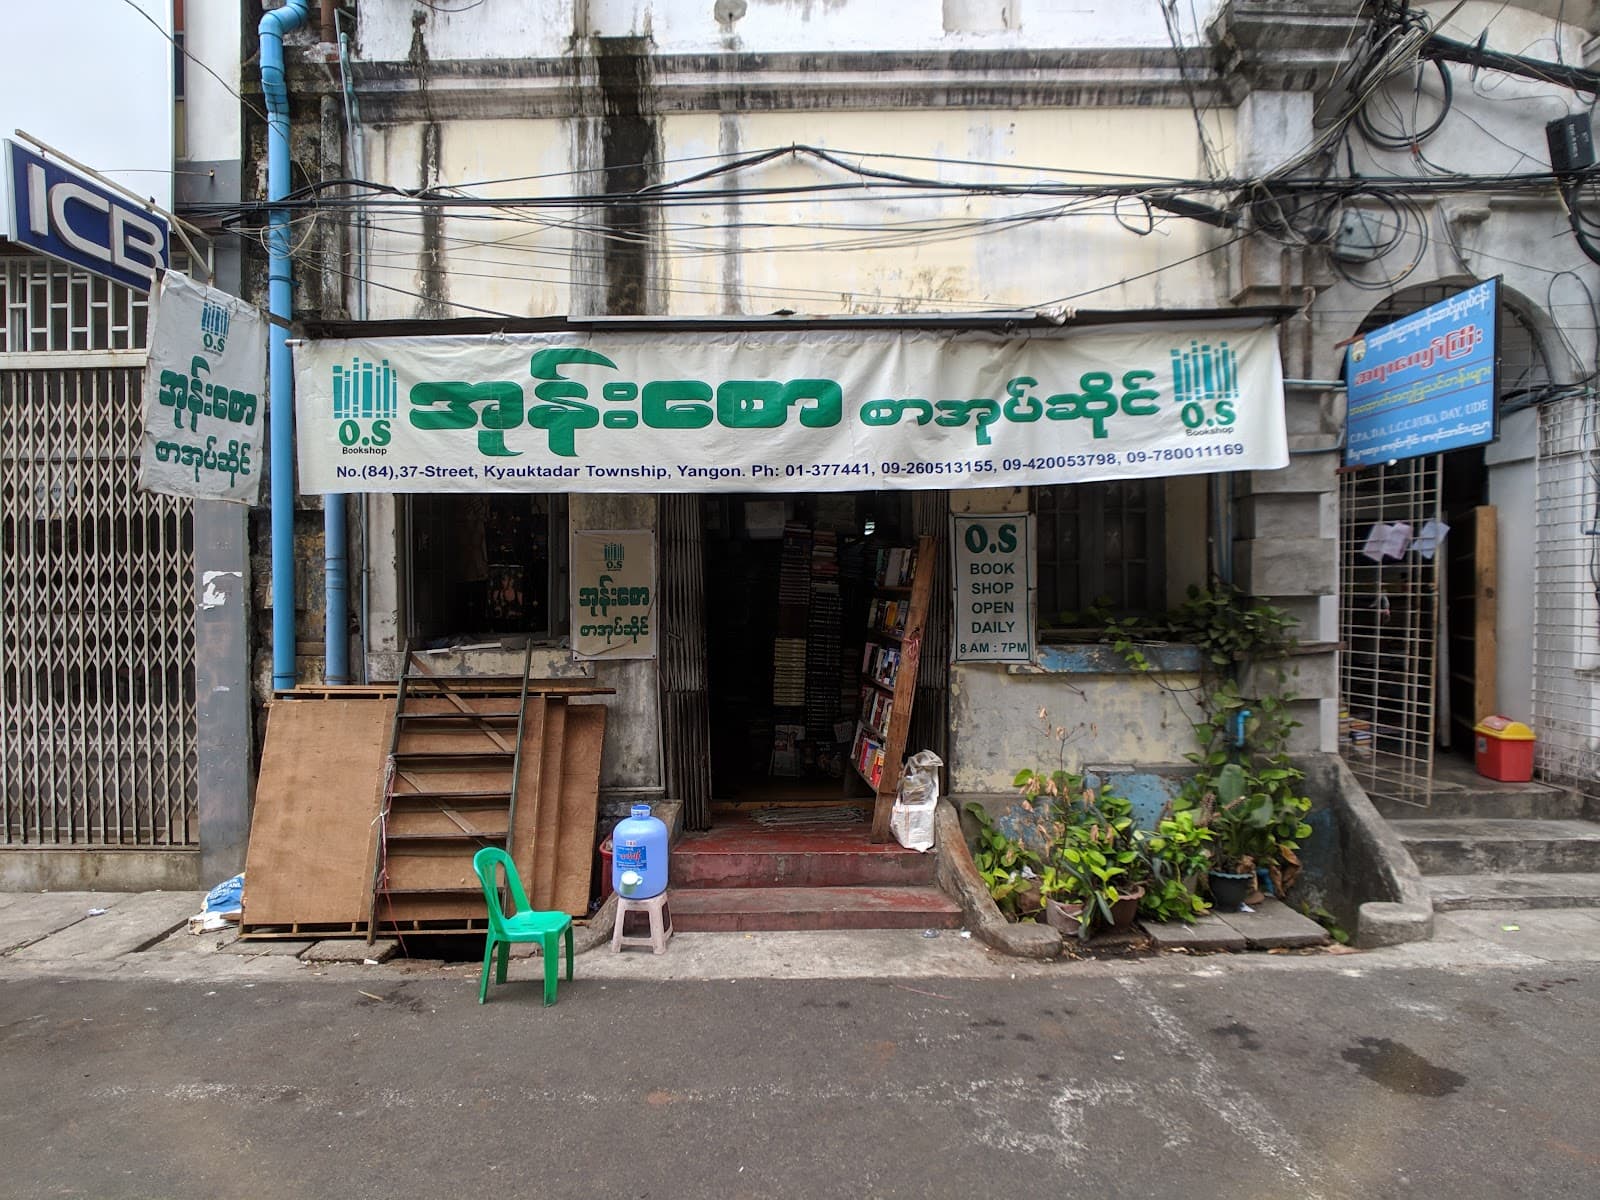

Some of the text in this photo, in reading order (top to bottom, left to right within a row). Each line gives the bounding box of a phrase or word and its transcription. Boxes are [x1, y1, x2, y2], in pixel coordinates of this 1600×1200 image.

[28, 162, 165, 279] ICB
[203, 333, 226, 352] O.S
[859, 370, 1161, 446] စာအုပ်ဆိုင်
[1181, 400, 1237, 429] O.S
[338, 419, 392, 446] O.S
[1185, 426, 1234, 437] Bookshop
[155, 435, 252, 488] စာအုပ်ဆိုင်
[336, 443, 1244, 481] No.(84),37-Street, Kyauktadar Township, Yangon. Ph: 01-377441, 09-260513155, 09-420053798, 09-780011169
[342, 446, 387, 456] Bookshop
[965, 523, 1018, 554] O.S
[970, 562, 1015, 575] BOOK
[971, 582, 1014, 595] SHOP
[971, 601, 1014, 614] OPEN
[580, 615, 649, 645] စာအုပ်ဆိုင်
[971, 621, 1016, 634] DAILY
[969, 642, 990, 653] AM
[1001, 642, 1028, 653] 7PM
